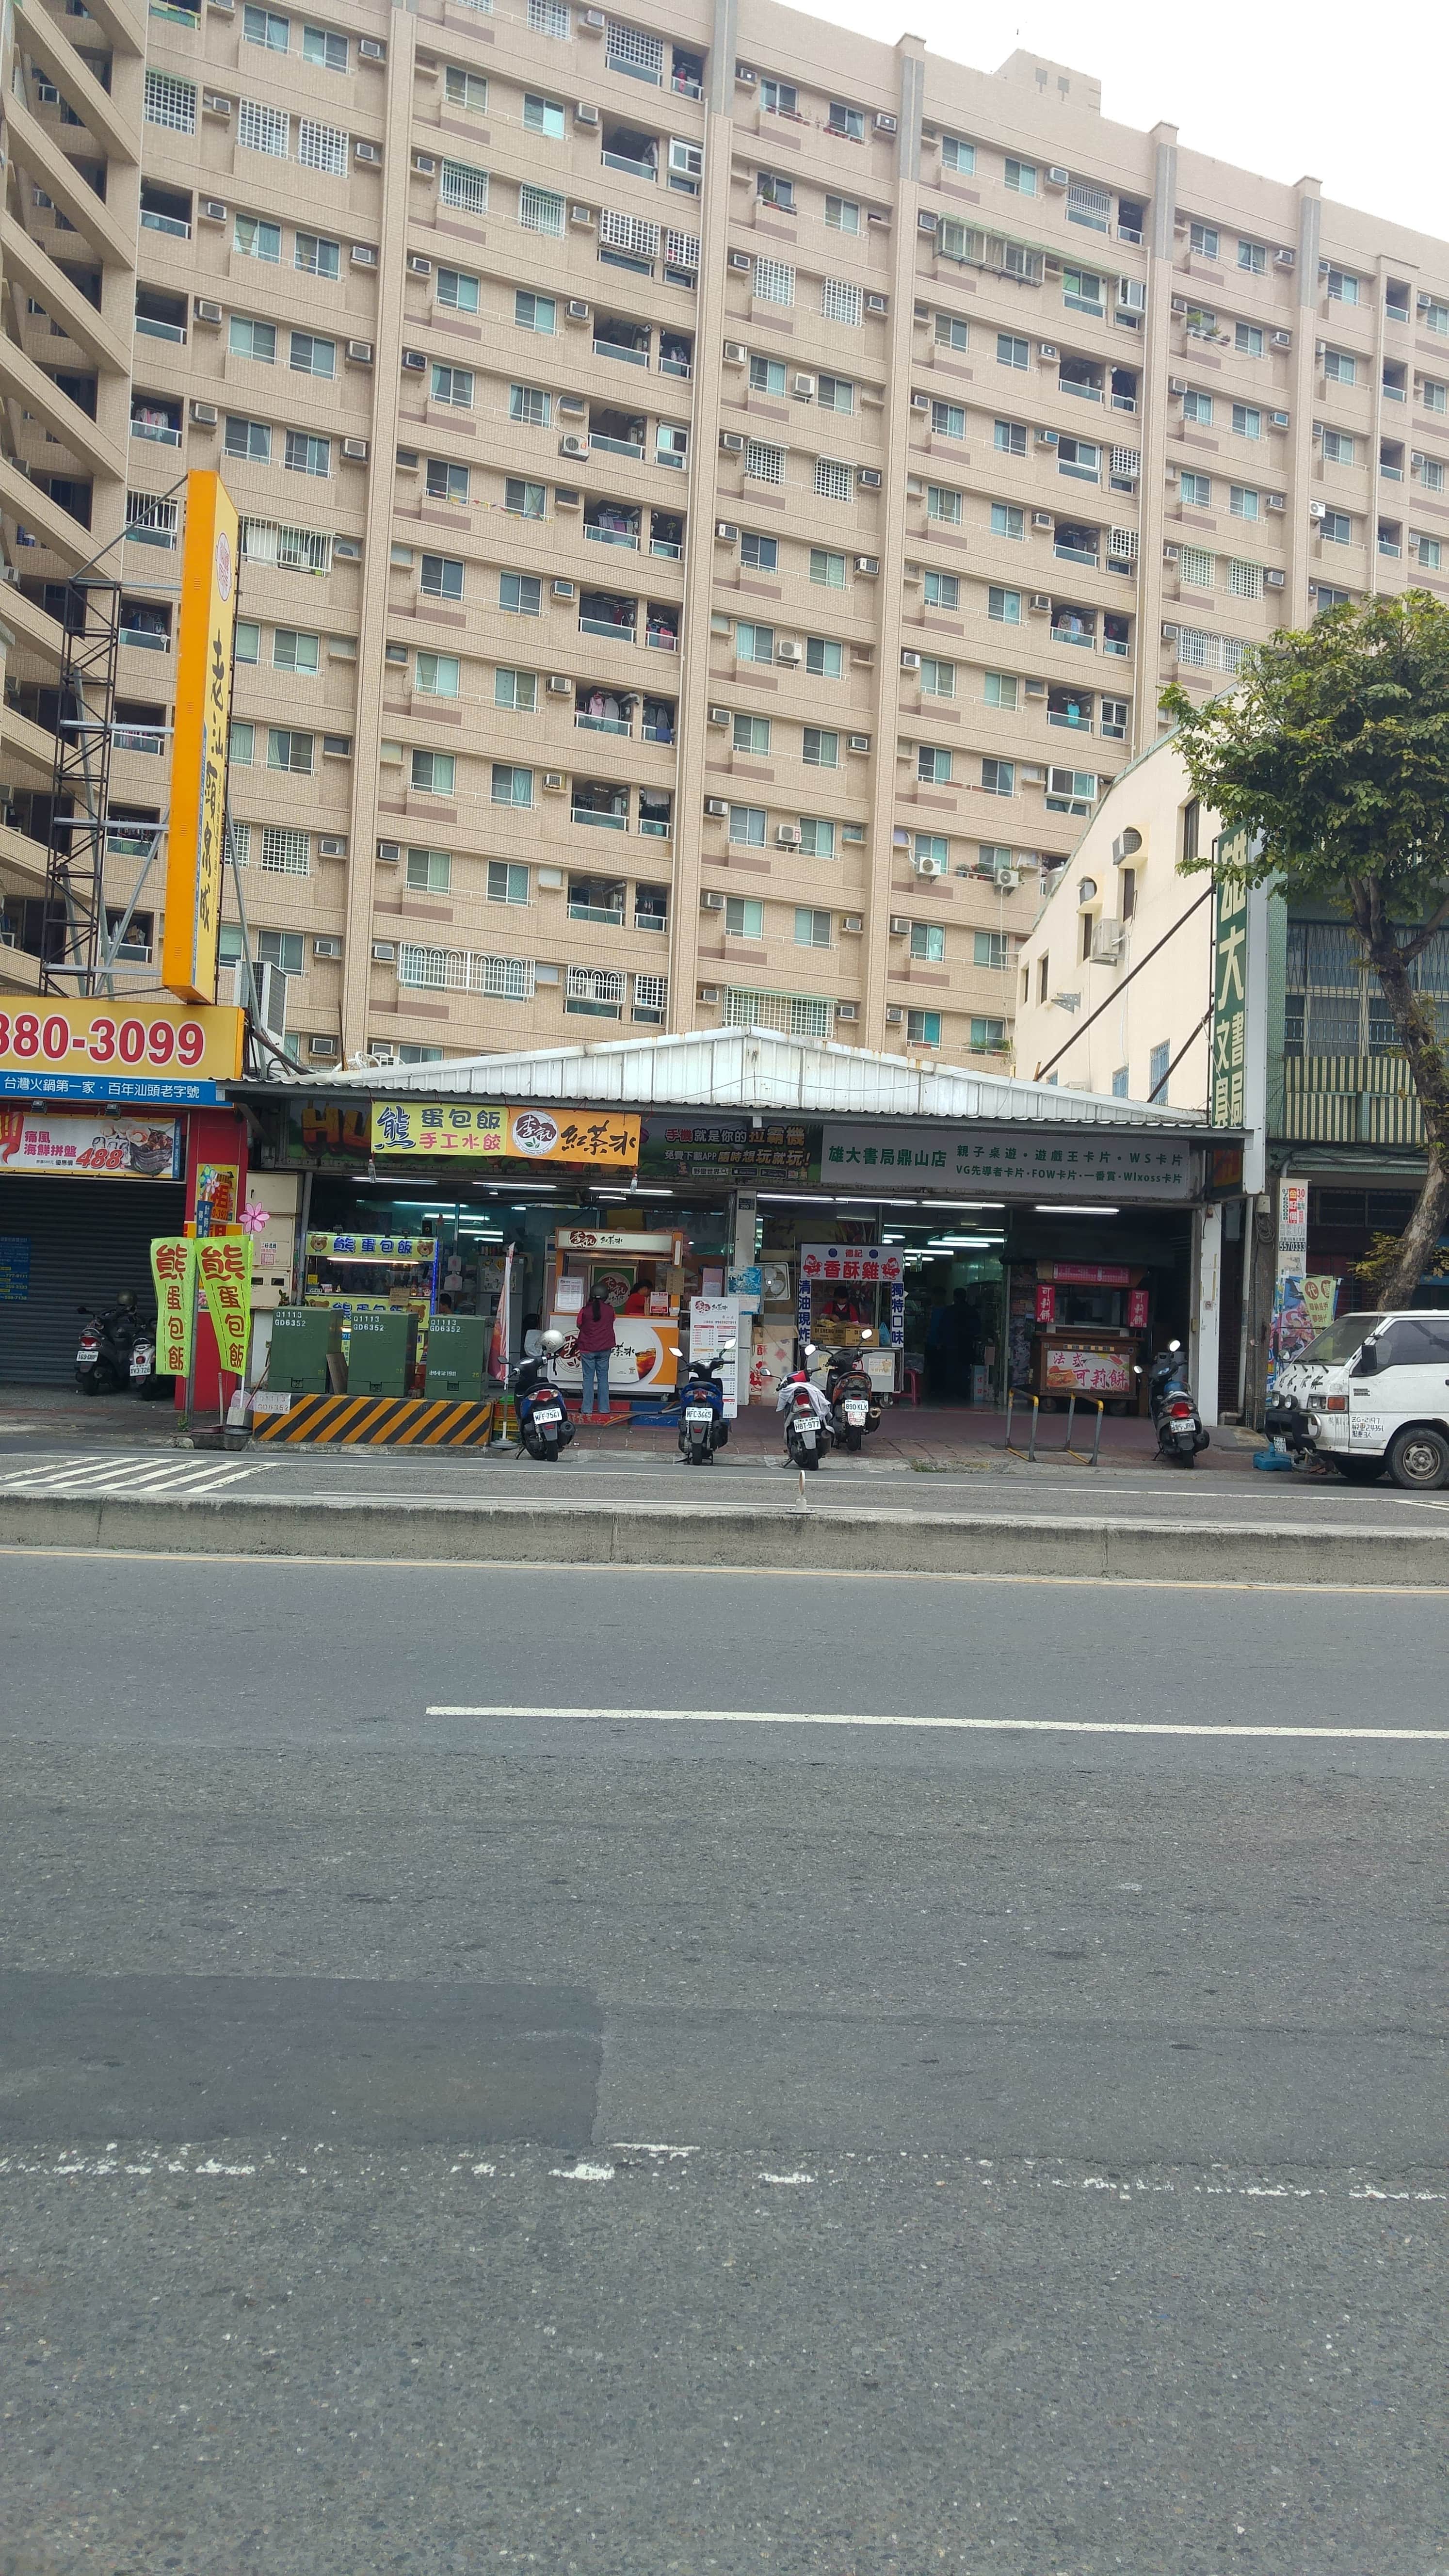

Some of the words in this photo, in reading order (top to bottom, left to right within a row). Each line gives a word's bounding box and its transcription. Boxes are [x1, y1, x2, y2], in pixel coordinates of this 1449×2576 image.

[1215, 1017, 1231, 1127] 文具
[1230, 1011, 1244, 1127] 書局
[374, 1105, 417, 1150] 熊
[421, 1108, 500, 1130] 蛋包飯
[24, 1131, 50, 1143] 痛風
[419, 1132, 501, 1151] 手工水餃
[24, 1143, 77, 1158] 海鮮拼盤
[76, 1148, 124, 1170] 488
[828, 1145, 947, 1168] 雄大書局鼎山店
[333, 1236, 413, 1255] 熊蛋包飯
[845, 1249, 863, 1258] 德記
[1279, 1241, 1306, 1251] 5570333
[824, 1260, 879, 1280] 香酥雞
[799, 1280, 811, 1342] 清油現炸
[891, 1283, 904, 1345] 獨特口味
[1054, 1352, 1083, 1368] 法式
[1072, 1368, 1127, 1390] 可莉餅
